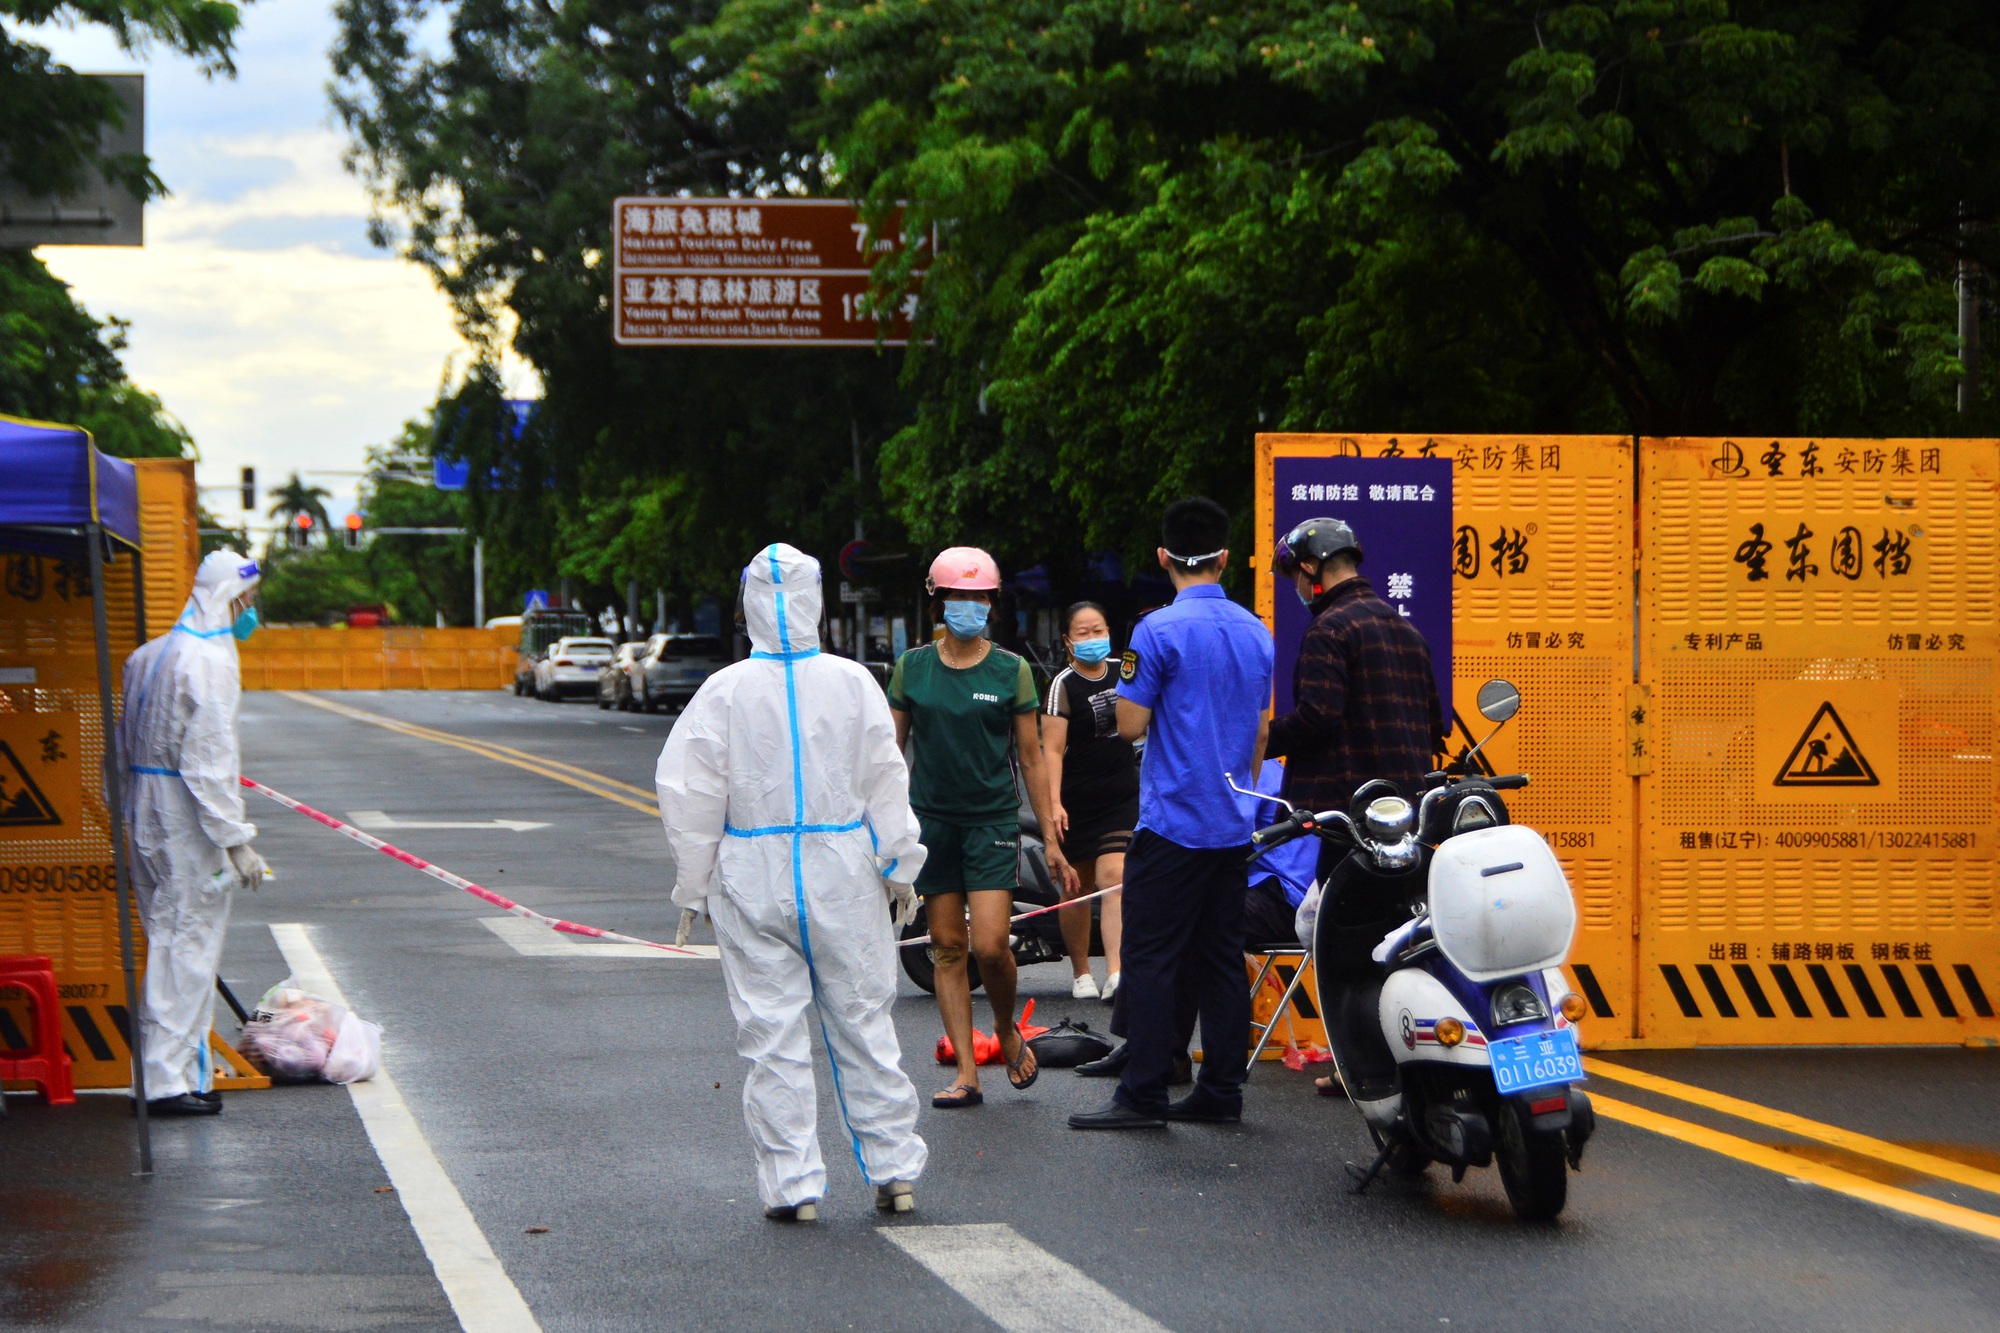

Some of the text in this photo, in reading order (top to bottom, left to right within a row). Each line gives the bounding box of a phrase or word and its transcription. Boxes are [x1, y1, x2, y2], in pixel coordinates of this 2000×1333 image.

[624, 206, 762, 235] 海旅免税城
[623, 237, 812, 252] Hainan Tourism Duty Free
[850, 223, 869, 253] 7
[624, 277, 821, 304] 亚龙湾森林旅游区
[624, 307, 820, 322] Yalong Bay Forest Tourist Area
[1291, 483, 1435, 502] 疫情防控 敬请配合
[1506, 631, 1585, 650] 仿冒必究
[1683, 632, 1763, 651] 专利产品
[1886, 632, 1966, 651] 仿冒必究
[1775, 832, 1976, 849] 4009905881/13022415881
[1771, 942, 1855, 962] 铺路钢板
[1870, 942, 1932, 962] 钢板桩
[1402, 1014, 1412, 1042] 8
[1512, 1039, 1557, 1061] 三亚
[1498, 1054, 1577, 1087] 0116039
